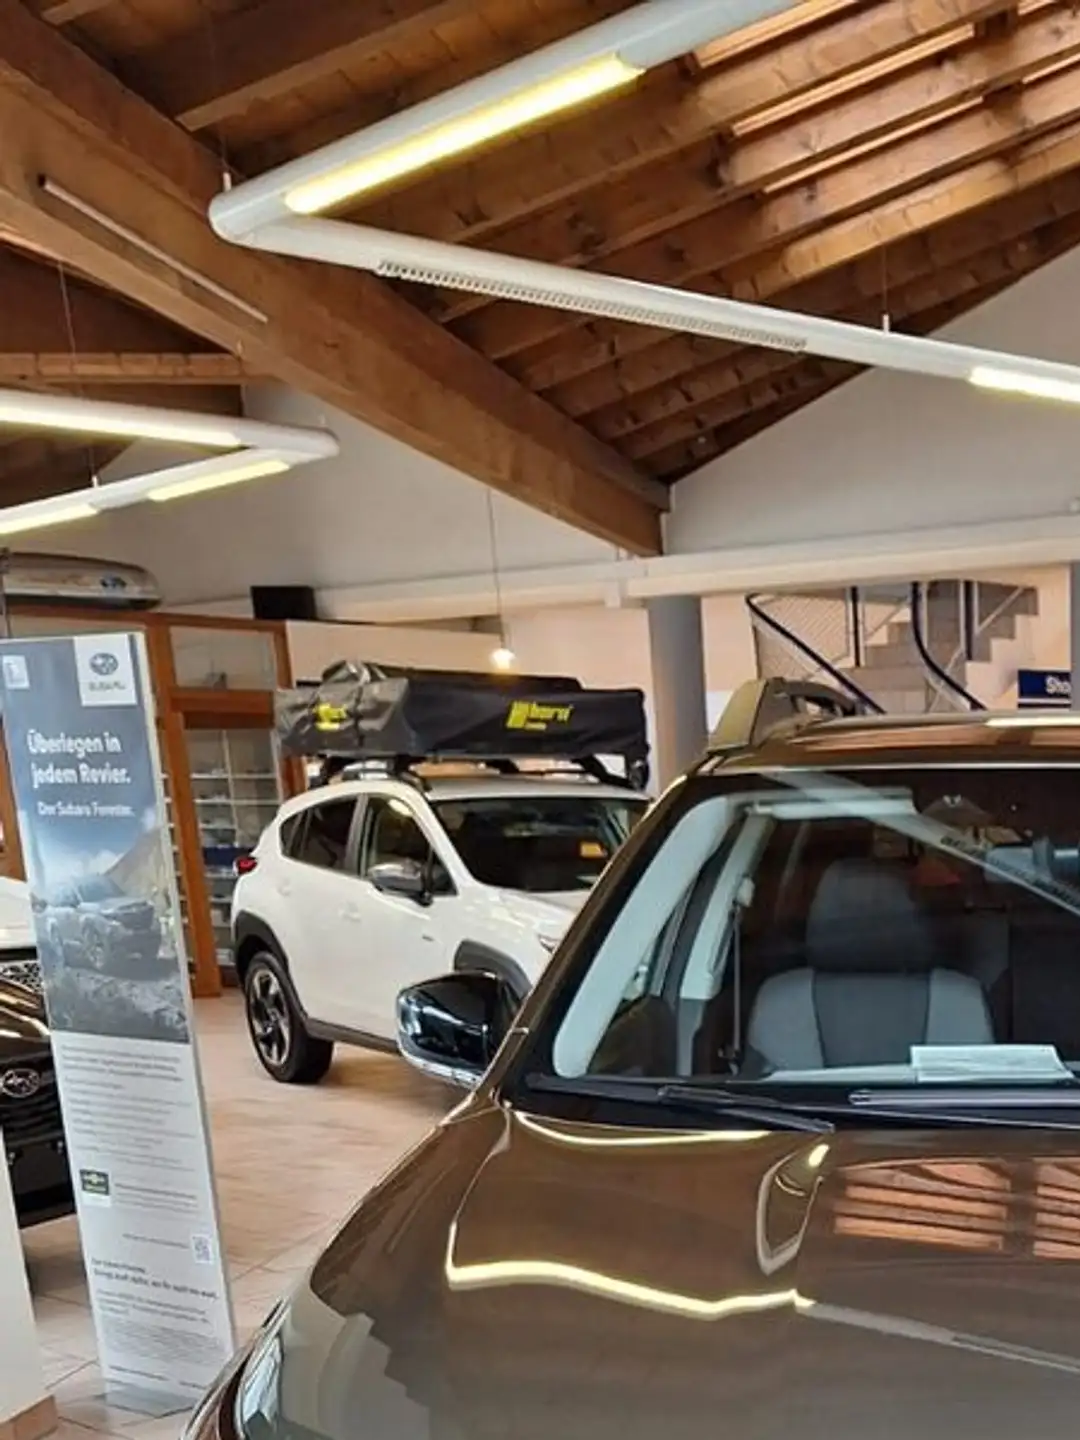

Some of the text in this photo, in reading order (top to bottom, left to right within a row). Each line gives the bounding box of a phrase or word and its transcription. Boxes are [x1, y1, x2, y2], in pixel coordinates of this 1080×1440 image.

[27, 729, 122, 759] Überlegen in
[31, 761, 131, 788] jedem Revier.
